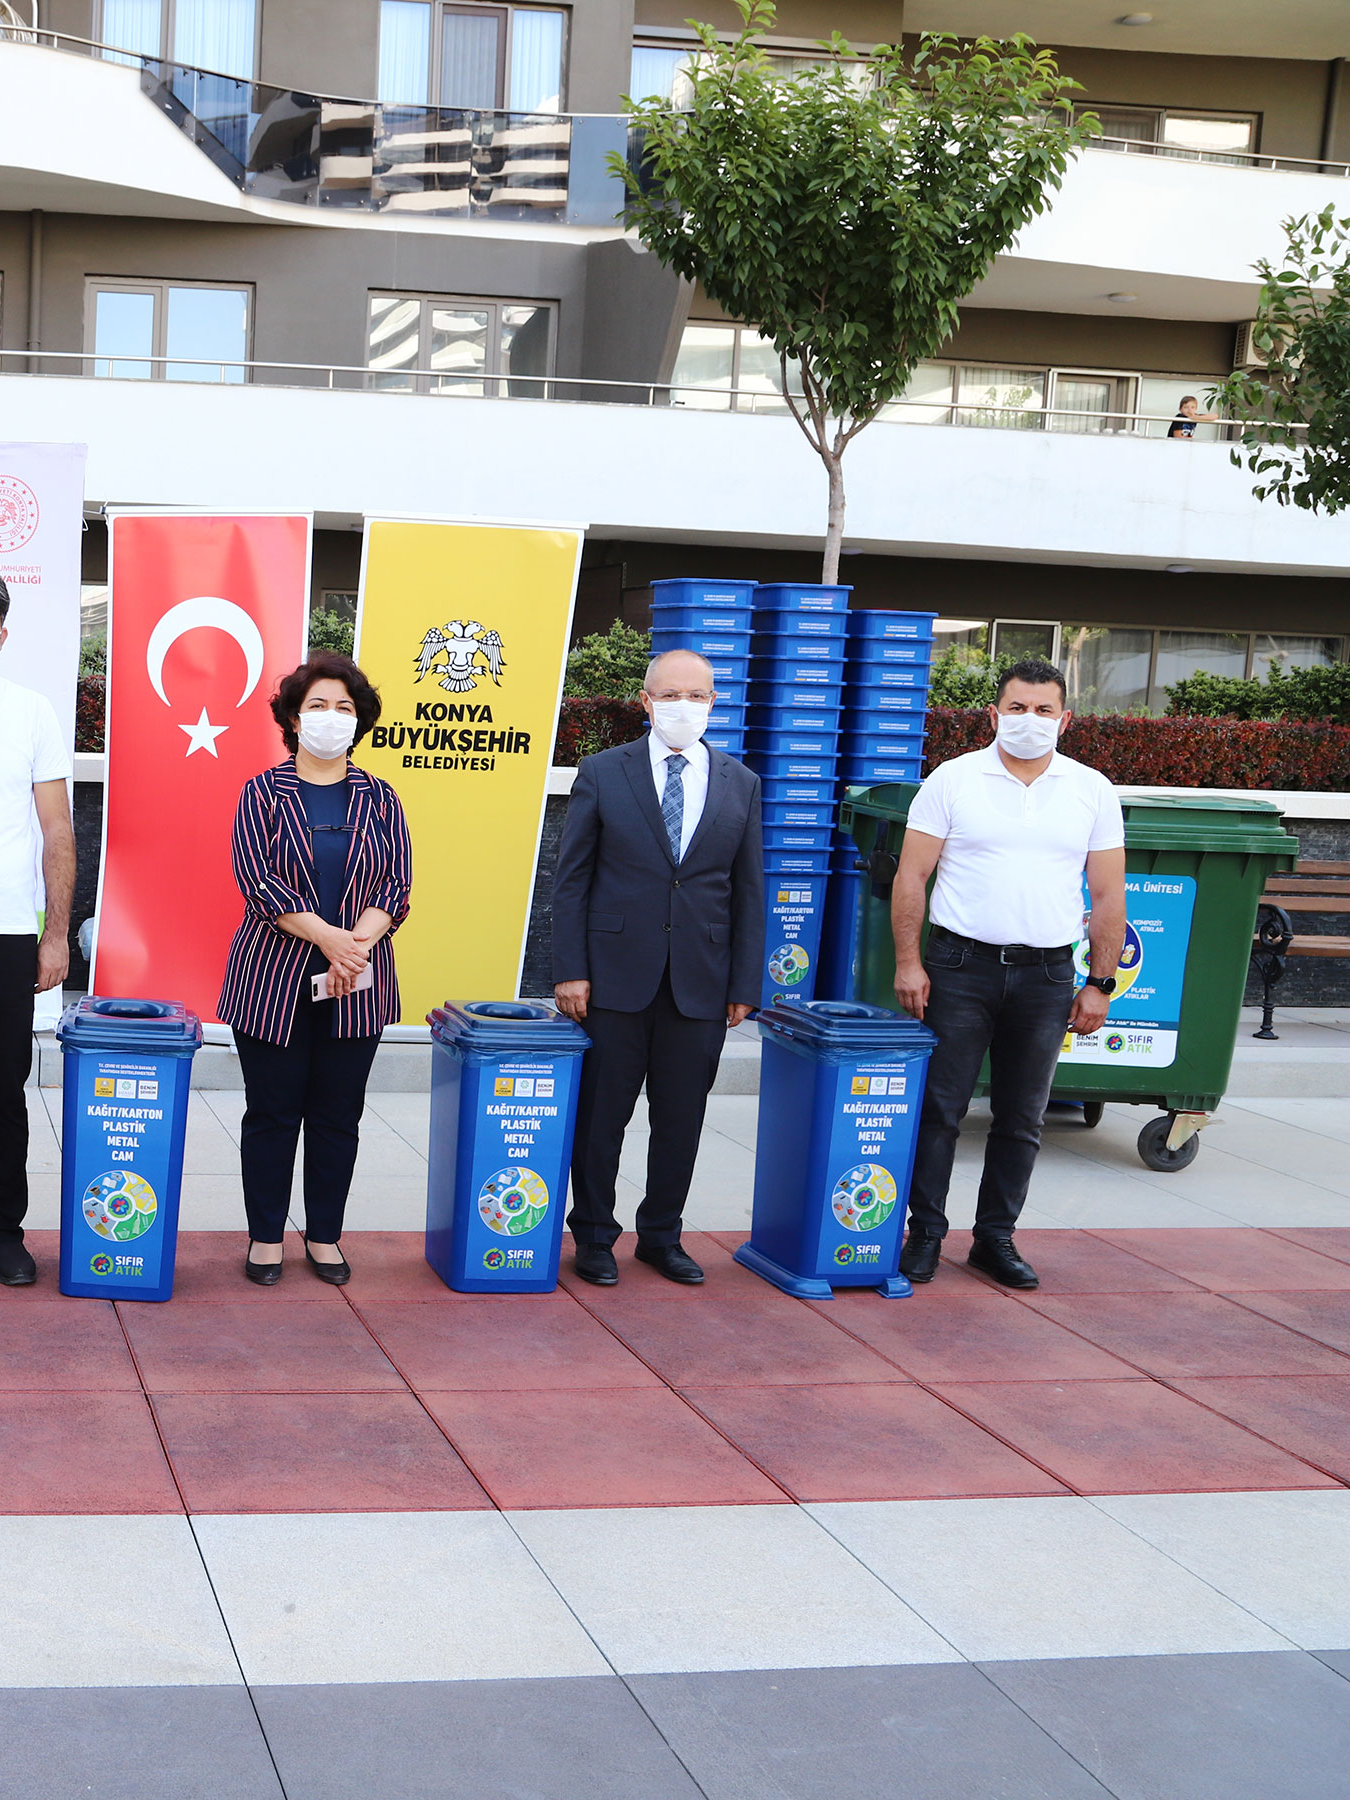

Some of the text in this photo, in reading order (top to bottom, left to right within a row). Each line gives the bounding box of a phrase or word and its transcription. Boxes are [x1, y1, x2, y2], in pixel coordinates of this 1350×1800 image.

[415, 702, 493, 723] KONYA
[371, 721, 531, 755] BÜYÜKŞEHİR
[402, 753, 495, 771] BELEDİYESİ
[1143, 881, 1183, 894] ÜNİTESİ
[781, 914, 805, 922] PLASTİK
[783, 923, 801, 931] METAL
[1127, 1034, 1153, 1044] SIFIR
[1127, 1044, 1152, 1053] ATIK
[87, 1104, 163, 1120] KAĞIT/KARTON
[486, 1103, 558, 1117] KAĞIT/KARTON
[843, 1101, 908, 1114] KAĞIT/KARTON
[102, 1120, 146, 1134] PLASTİK
[500, 1117, 541, 1131] PLASTİK
[855, 1115, 893, 1128] PLASTİK
[107, 1135, 140, 1148] METAL
[504, 1133, 535, 1144] METAL
[858, 1131, 886, 1141] METAL
[508, 1147, 529, 1158] CAM
[861, 1144, 881, 1155] CAM
[111, 1150, 134, 1162] CAM
[507, 1249, 534, 1259] SIFIR
[856, 1244, 881, 1254] SIFIR
[115, 1255, 144, 1267] SIFIR
[506, 1259, 532, 1269] ATIK
[855, 1254, 879, 1263] ATIK
[115, 1266, 143, 1276] ATIK
